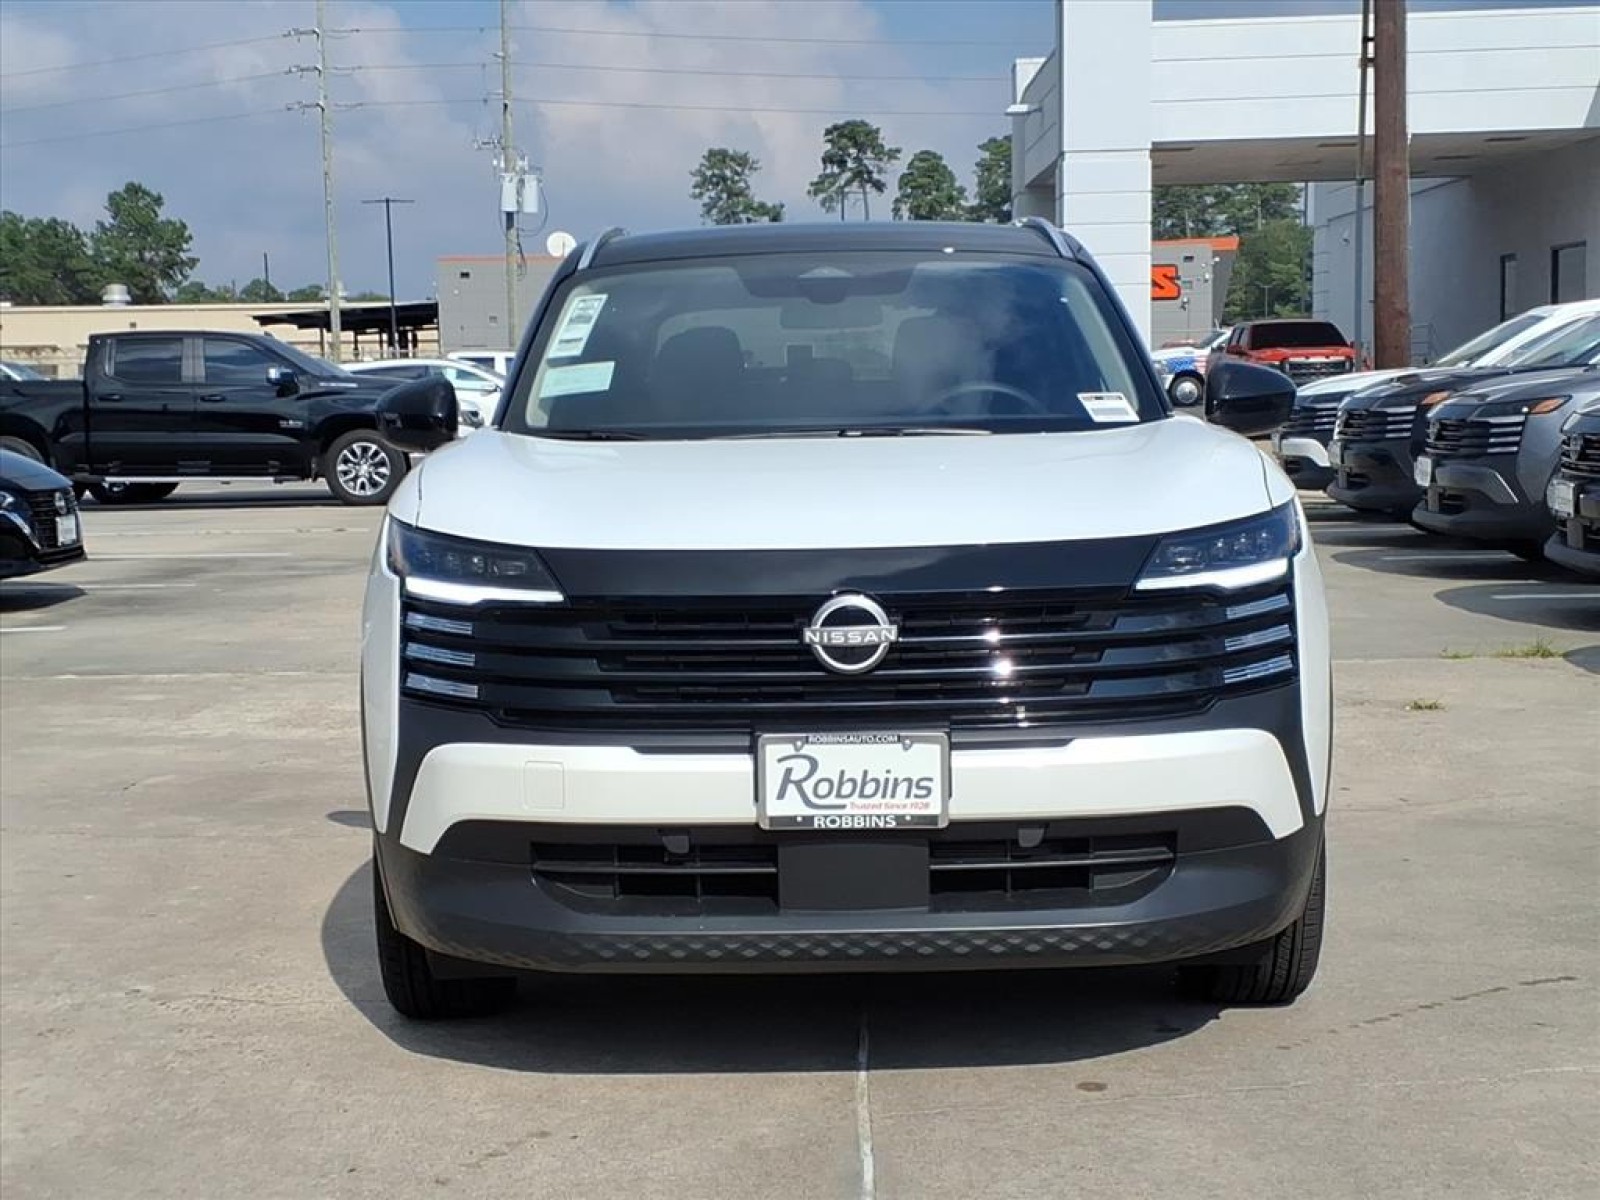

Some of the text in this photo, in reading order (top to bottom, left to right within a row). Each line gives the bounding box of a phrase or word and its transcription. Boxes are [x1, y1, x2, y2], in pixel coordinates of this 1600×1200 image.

[804, 628, 897, 643] NISSAN
[809, 735, 897, 743] ROBBINSAUTO.COM
[776, 754, 934, 810] Robbins
[851, 802, 882, 810] Trusted
[884, 802, 908, 810] Since
[814, 815, 897, 828] ROBBINS
